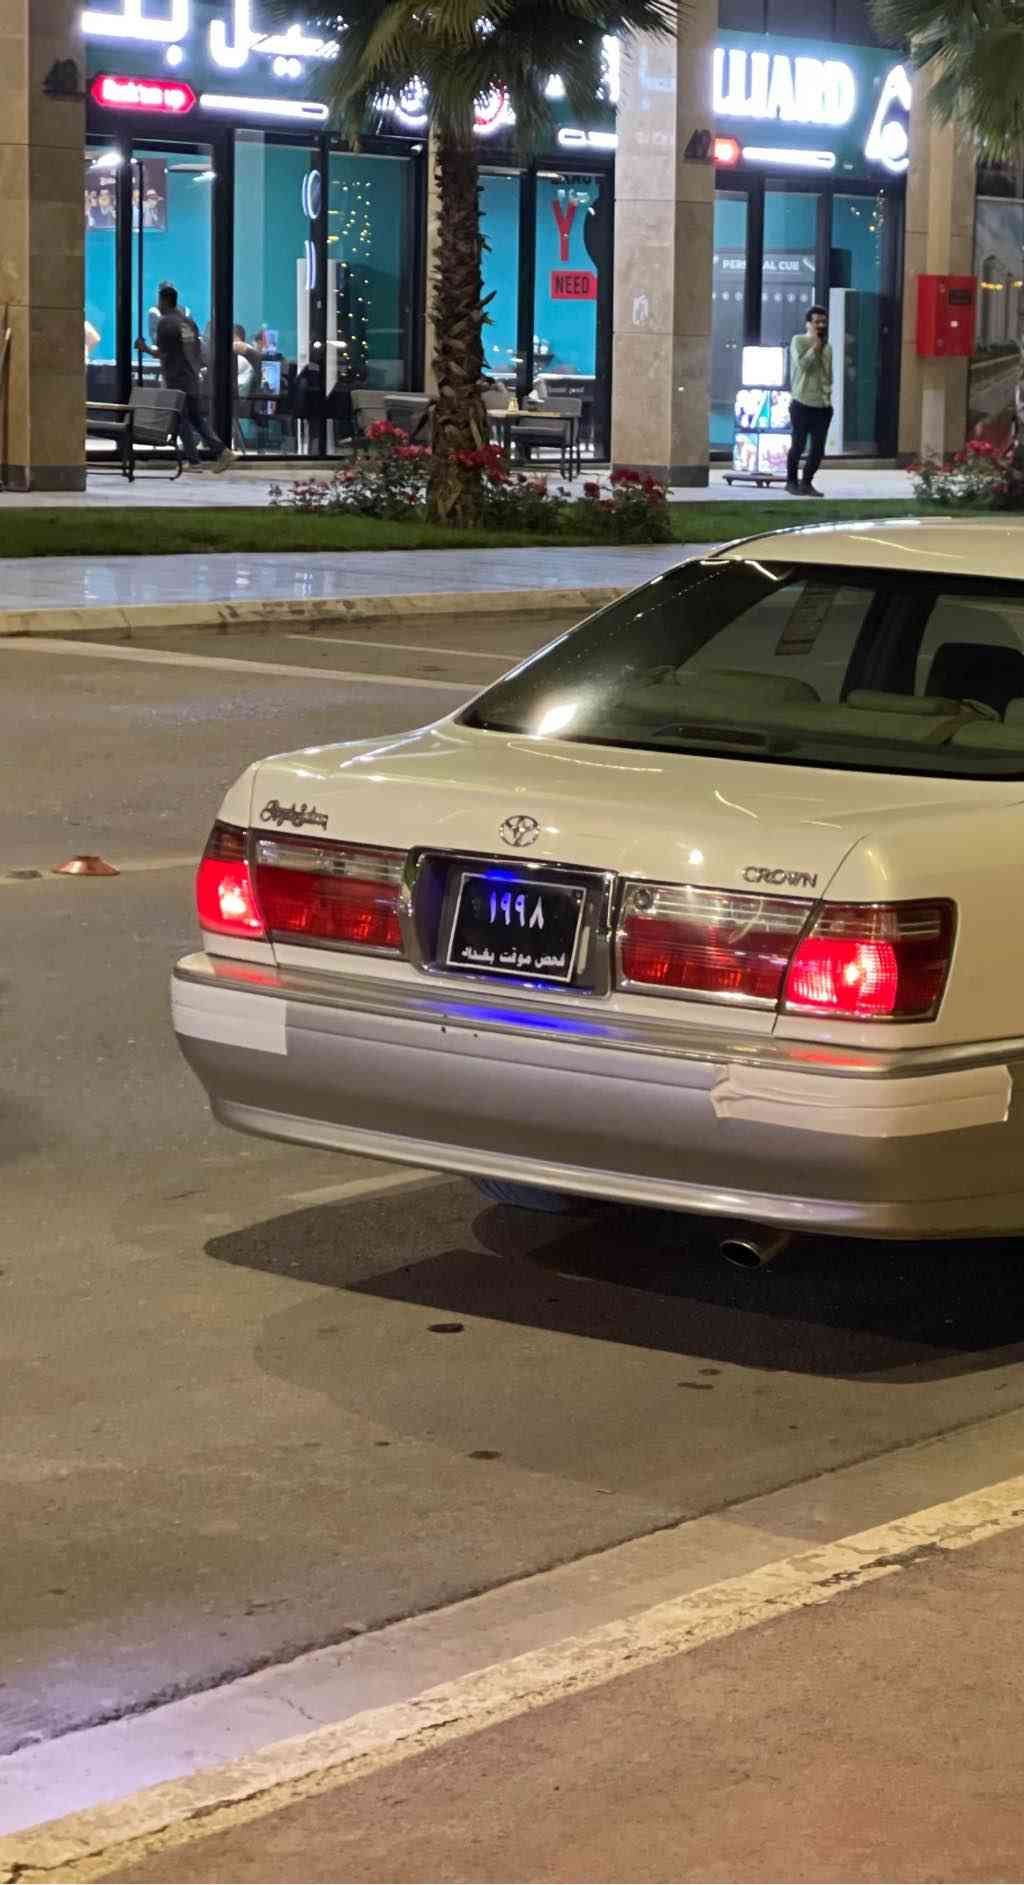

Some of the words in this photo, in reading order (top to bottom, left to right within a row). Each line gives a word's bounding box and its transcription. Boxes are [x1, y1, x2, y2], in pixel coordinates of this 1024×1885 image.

[713, 47, 857, 126] LLIARD
[722, 259, 777, 271] PERSAL
[778, 260, 800, 271] CUE
[554, 275, 591, 295] NEED
[742, 865, 818, 889] CROWN
[488, 890, 546, 930] ١٩٩٨
[461, 945, 496, 965] بغداد
[534, 952, 567, 969] فحص
